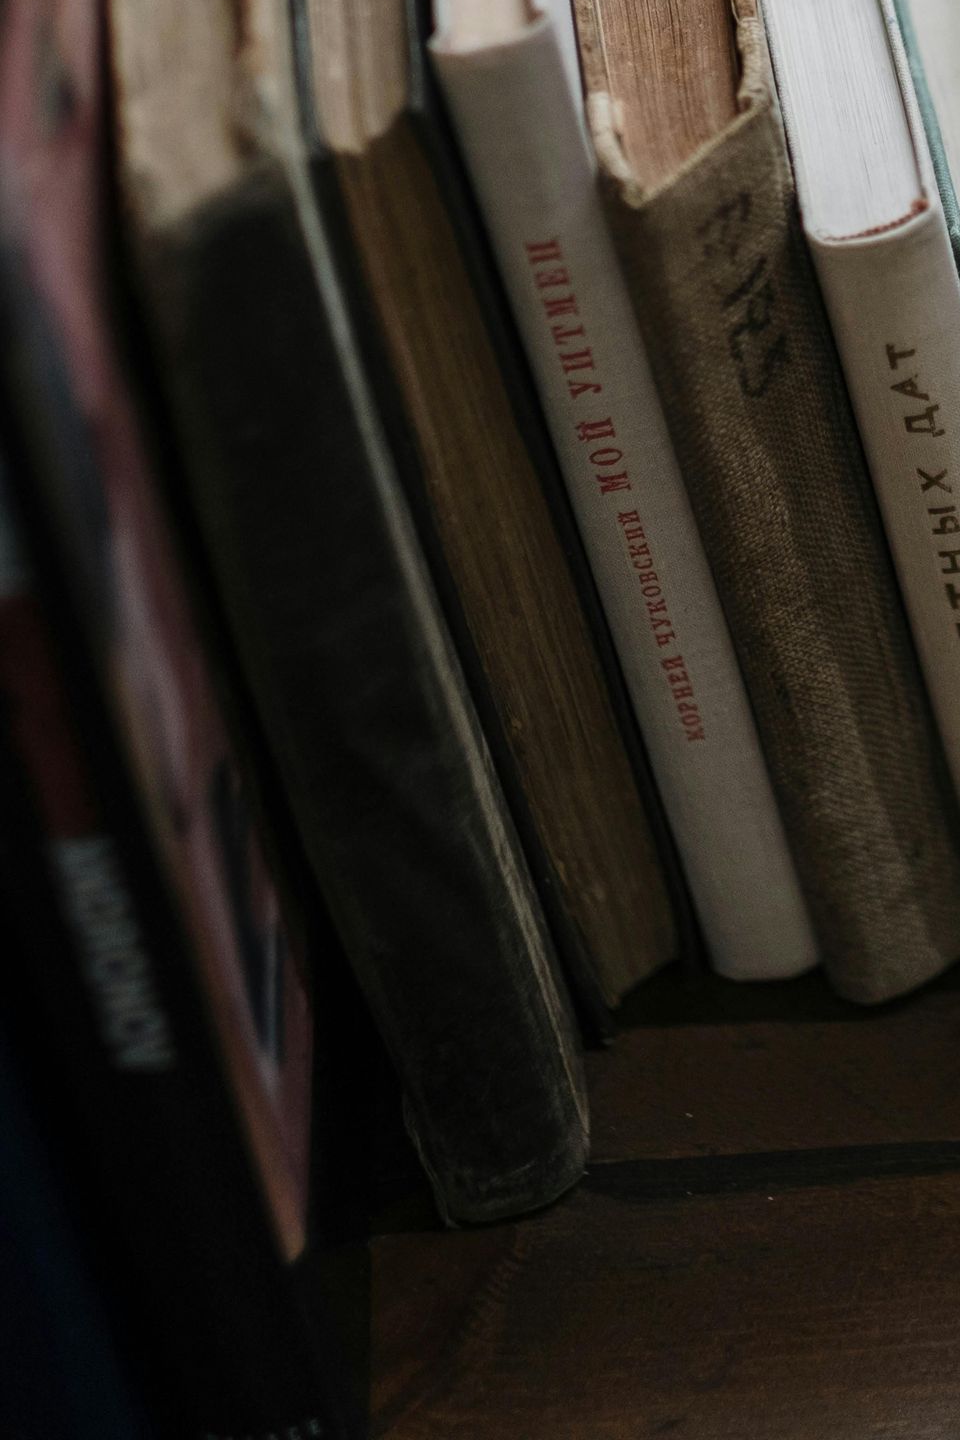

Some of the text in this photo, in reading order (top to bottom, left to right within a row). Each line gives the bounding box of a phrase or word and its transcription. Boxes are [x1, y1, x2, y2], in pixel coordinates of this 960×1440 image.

[526, 234, 706, 742] КОРНЕЙ ЧУКОВСКИЙ МОЙ УИТМЕН
[886, 343, 946, 438] ДАТ
